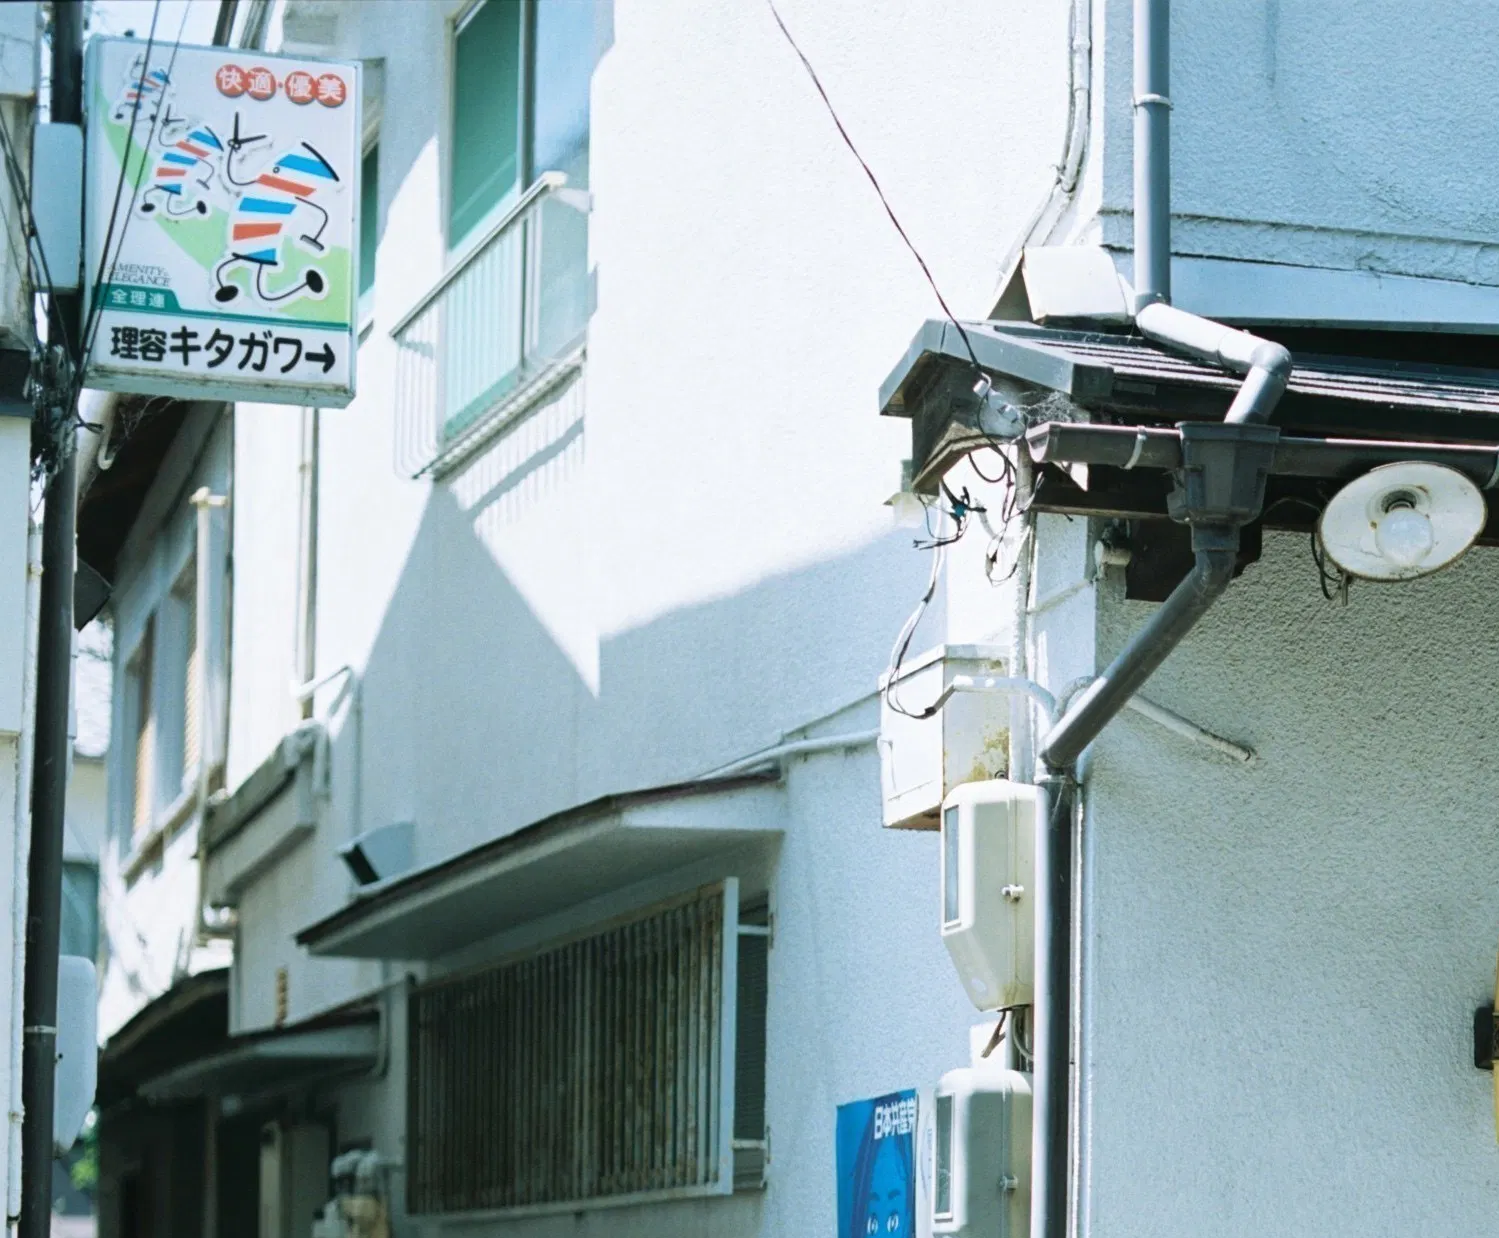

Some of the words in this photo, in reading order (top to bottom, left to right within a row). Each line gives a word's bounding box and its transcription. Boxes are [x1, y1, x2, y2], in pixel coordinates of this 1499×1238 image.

[217, 66, 345, 105] 快適・優美
[109, 269, 171, 287] LEGANCE
[111, 288, 165, 309] 全理連
[110, 326, 303, 374] 理容キタガワ
